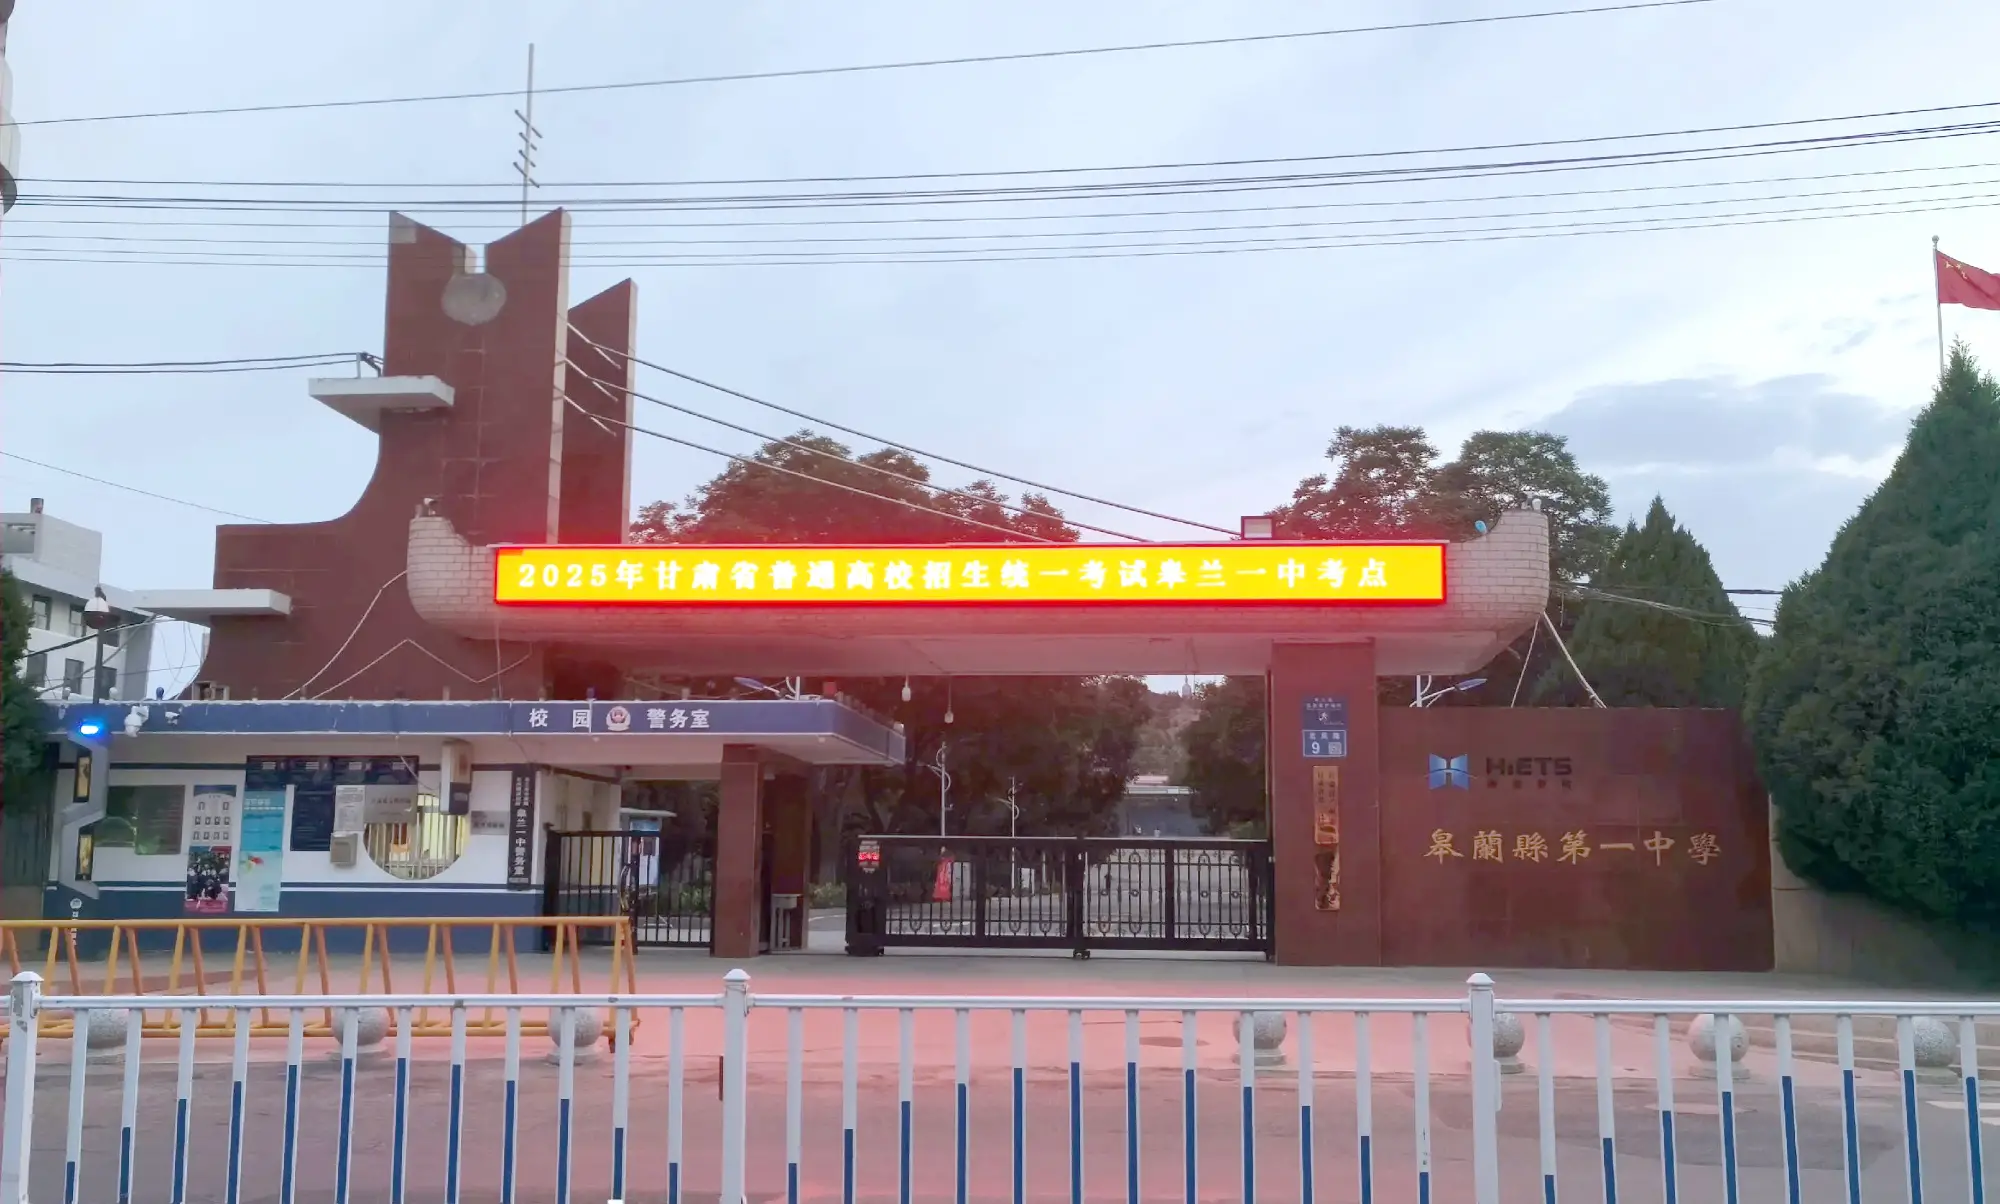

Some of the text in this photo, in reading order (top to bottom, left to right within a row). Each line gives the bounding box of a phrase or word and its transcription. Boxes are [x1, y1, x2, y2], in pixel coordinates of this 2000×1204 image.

[518, 557, 1388, 590] 2025年甘肃省普通高校招生统一考试皋兰一中考点
[529, 708, 711, 728] 校园 警务室
[1311, 741, 1321, 755] 9
[1423, 828, 1722, 867] 皋蘭縣第一中學
